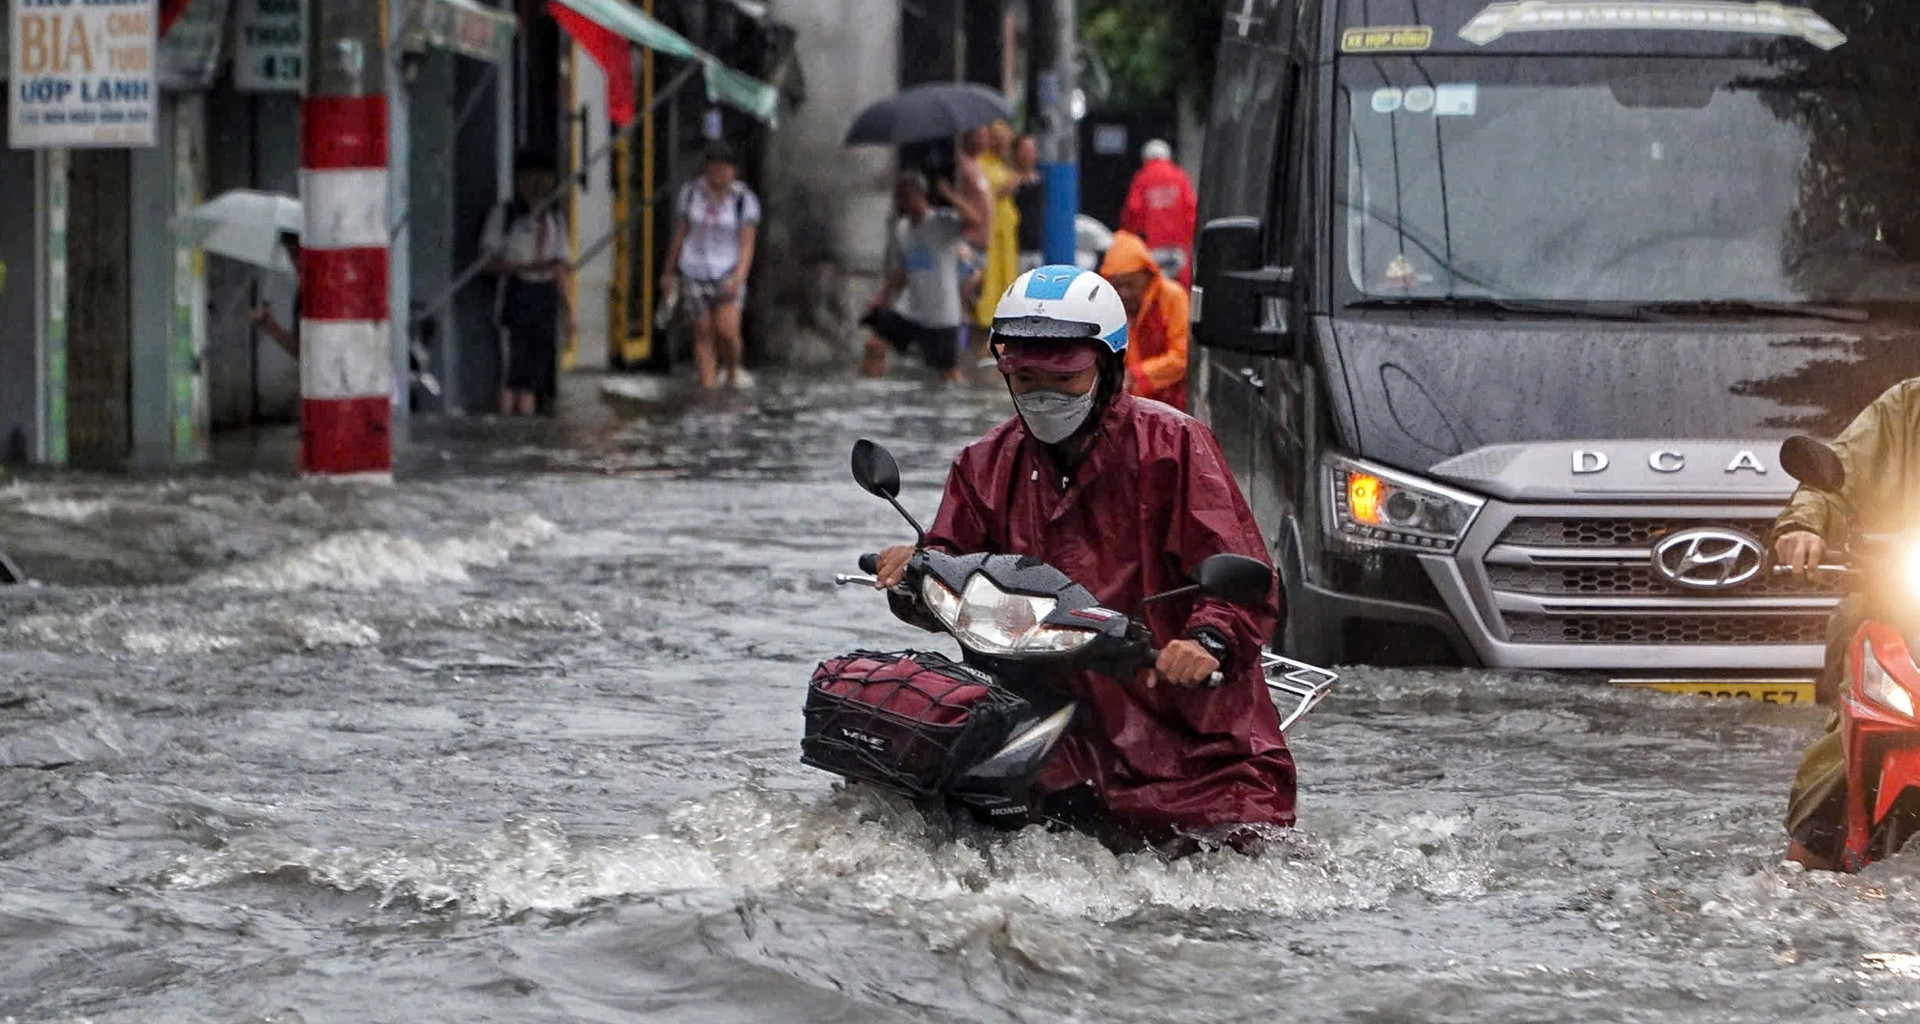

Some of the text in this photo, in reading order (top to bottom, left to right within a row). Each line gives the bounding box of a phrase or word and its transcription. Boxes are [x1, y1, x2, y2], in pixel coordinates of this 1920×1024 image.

[21, 14, 94, 73] BIA
[1572, 449, 1767, 474] DCA
[990, 805, 1028, 816] HONDA
